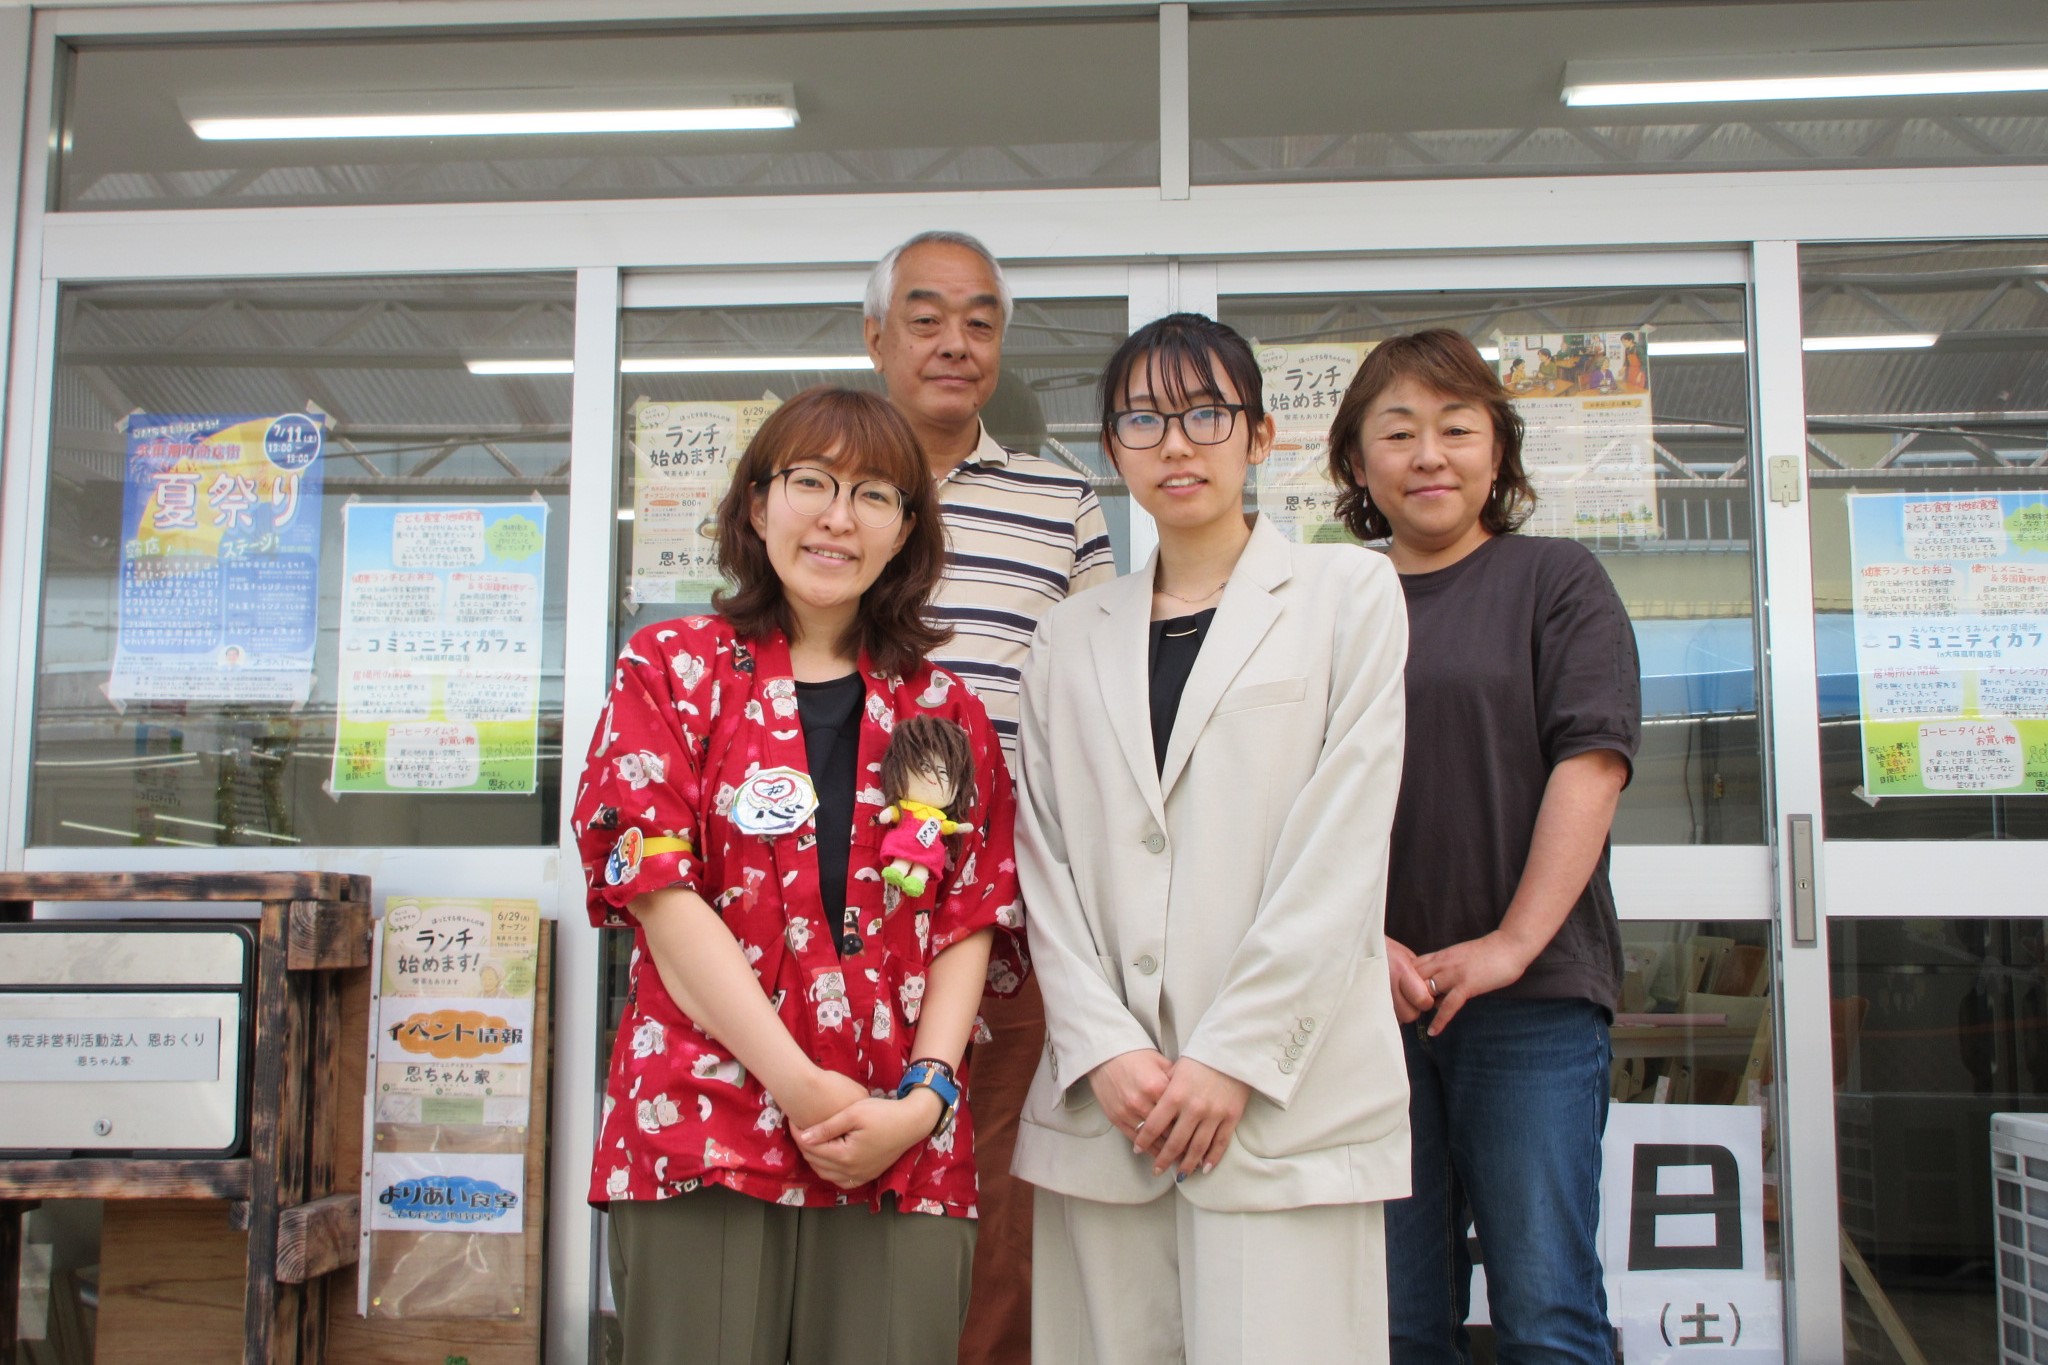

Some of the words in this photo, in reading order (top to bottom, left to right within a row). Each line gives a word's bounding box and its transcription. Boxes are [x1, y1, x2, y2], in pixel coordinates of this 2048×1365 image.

[1284, 365, 1341, 391] ランチ
[1270, 389, 1342, 412] 始めます
[665, 423, 720, 448] ランチ
[153, 472, 299, 529] 夏祭り
[659, 551, 719, 566] 恩ちゃん
[1861, 565, 1952, 577] 健康ランチとお弁当
[1990, 574, 2048, 584] &多国籍料理
[1911, 624, 2037, 634] みんなでつくるみんなの居場所
[368, 638, 527, 653] コミュニティカフェ
[1887, 633, 2042, 649] コミュニティカフ
[1920, 725, 1996, 737] コーヒータイムや
[1976, 735, 2016, 746] お買い物
[499, 923, 527, 931] オープン
[416, 928, 473, 953] ランチ
[398, 953, 480, 974] 始めます!
[7, 1033, 138, 1048] 特定非営利活動法人
[148, 1033, 205, 1047] 恩おくり
[388, 1023, 523, 1044] イベント情報
[405, 1066, 491, 1084] 恩ちゃん家
[379, 1185, 518, 1209] よりあい食堂
[1628, 1143, 1743, 1271] 日
[1660, 1302, 1741, 1347] (土)
